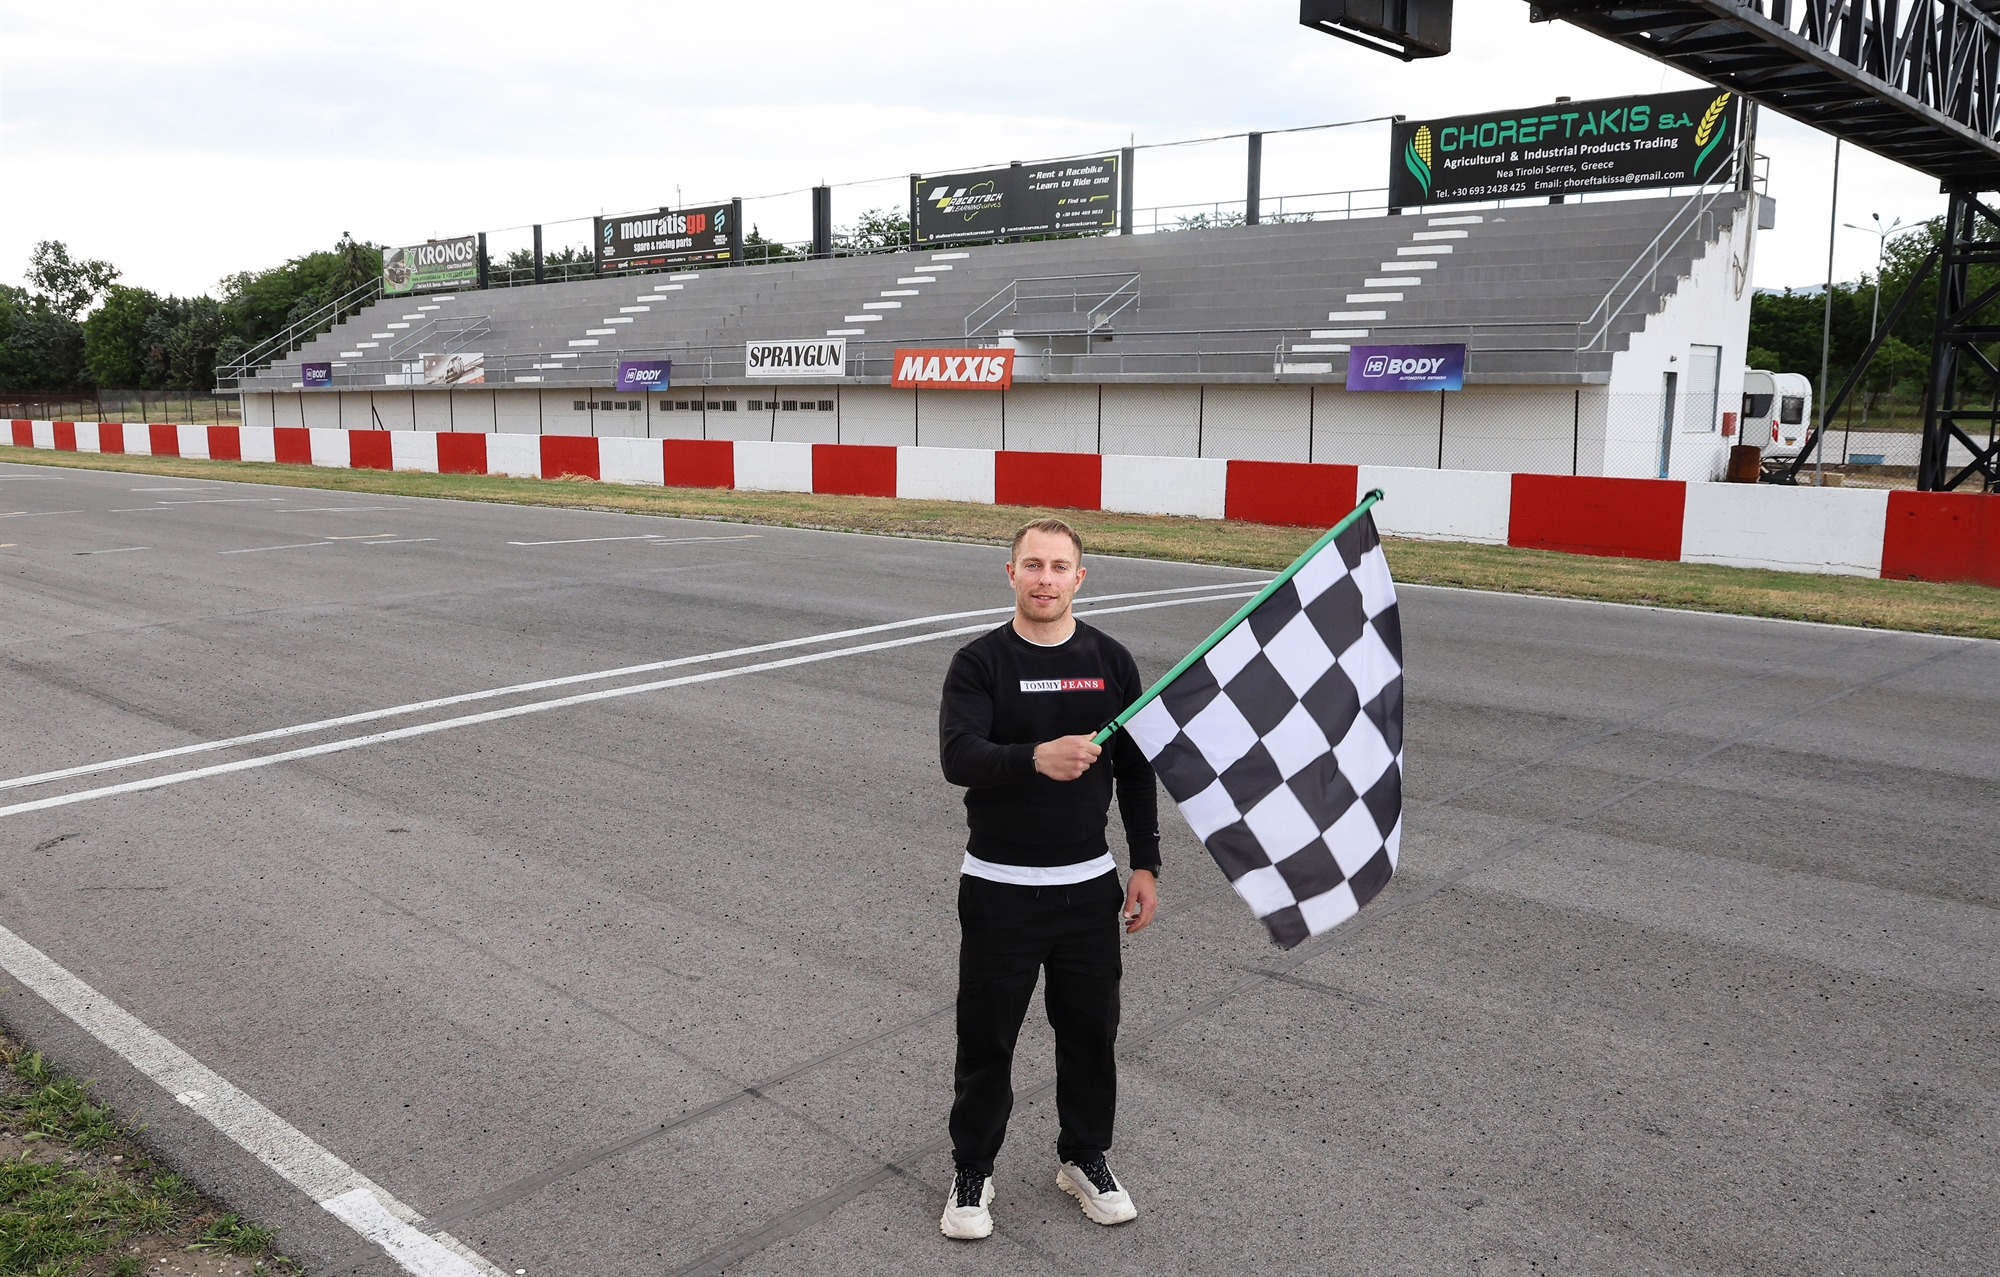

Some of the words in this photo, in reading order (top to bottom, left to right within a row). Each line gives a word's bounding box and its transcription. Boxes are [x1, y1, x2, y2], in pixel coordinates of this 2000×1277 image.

[1440, 105, 1651, 152] CHOREFTAKIS
[1443, 152, 1505, 170] Agricultural
[1510, 151, 1519, 161] &
[1524, 144, 1577, 160] Industrial
[1580, 141, 1631, 155] Products
[1633, 136, 1679, 149] Trading
[1036, 170, 1056, 180] Rent
[1066, 165, 1104, 176] Racebike
[1496, 170, 1514, 178] Nea
[1515, 165, 1544, 177] Tiroloi
[1545, 164, 1577, 174] Serres,
[1581, 160, 1614, 171] Greece
[1036, 181, 1059, 190] Learn
[1073, 177, 1091, 187] Ride
[1436, 189, 1450, 199] Tel.
[1451, 187, 1468, 197] +30
[1469, 185, 1485, 196] 693
[1486, 183, 1508, 194] 2428
[1509, 182, 1526, 192] 425
[1534, 179, 1562, 190] Email:
[1564, 170, 1685, 187] choreftakissa@gmail.com
[620, 213, 706, 240] mouratisgp
[418, 240, 473, 265] KRONOS
[633, 239, 650, 253] spare
[651, 240, 656, 250] &
[656, 238, 675, 250] racing
[676, 236, 693, 250] parts
[749, 344, 842, 368] SPRAYGUN
[312, 369, 327, 379] BODY
[635, 369, 662, 381] BODY
[897, 356, 1006, 383] MAXXIS
[1387, 358, 1446, 374] BODY
[1024, 681, 1060, 690] TOMMY
[1062, 680, 1099, 689] JEANS
